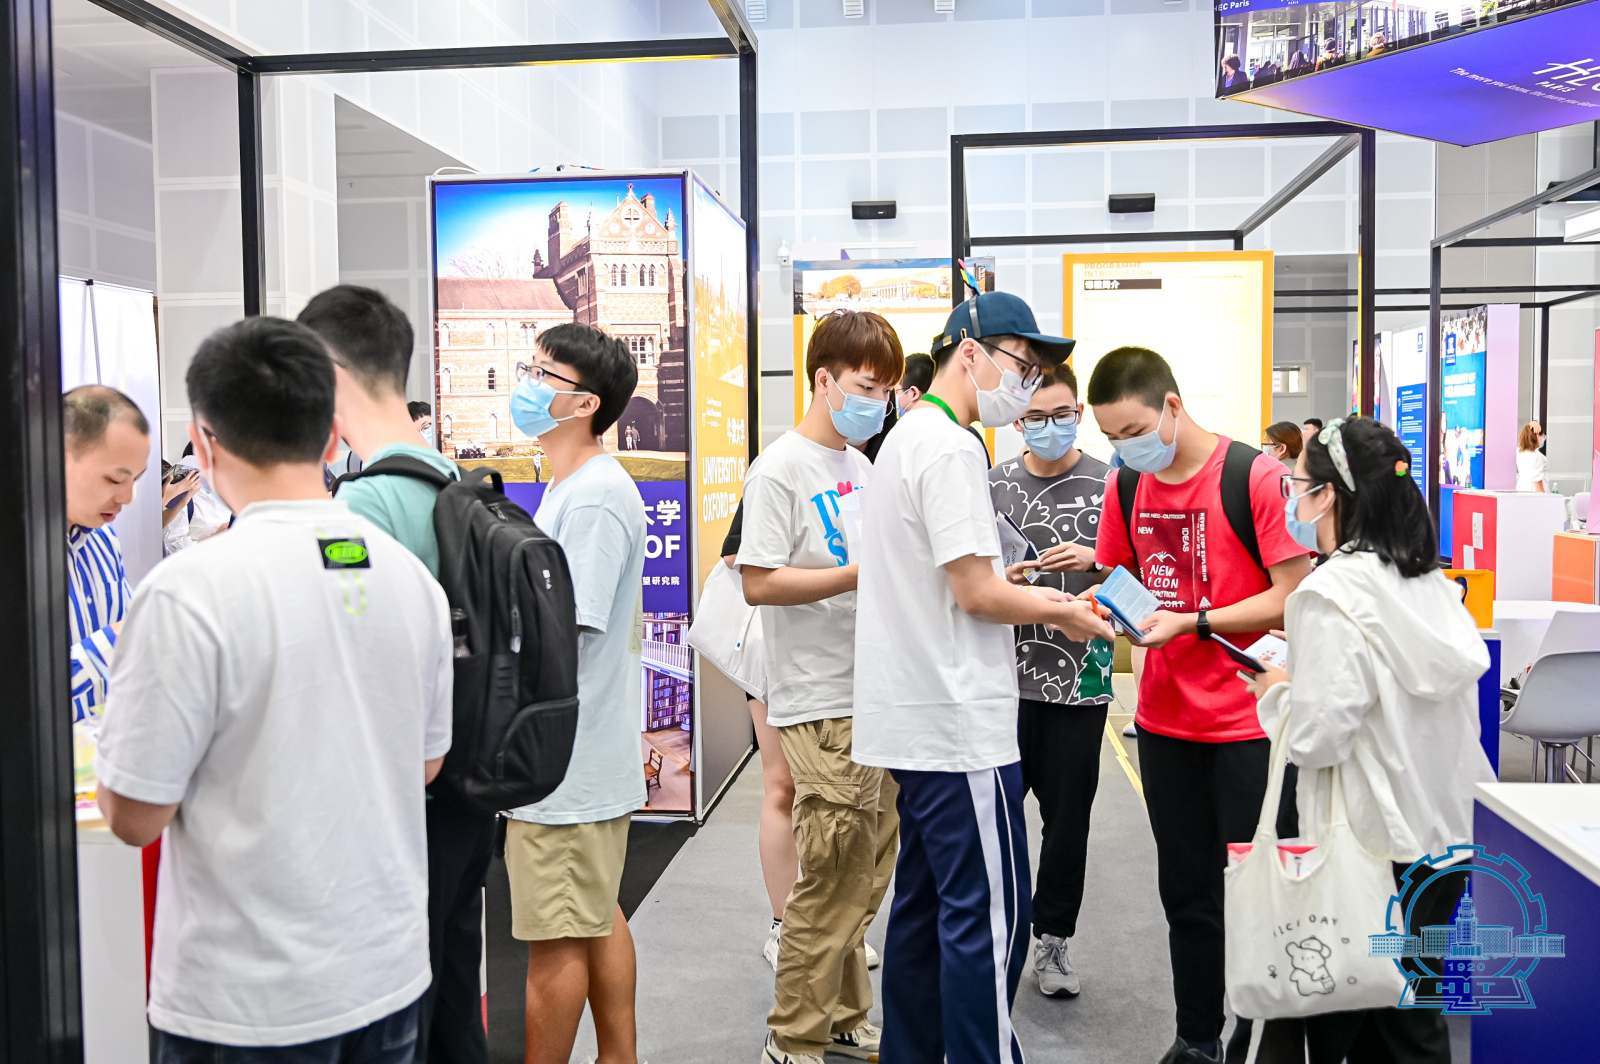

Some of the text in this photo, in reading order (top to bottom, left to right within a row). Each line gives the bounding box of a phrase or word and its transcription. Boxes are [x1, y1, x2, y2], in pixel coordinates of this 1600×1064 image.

[1230, 0, 1250, 9] Paris
[1535, 81, 1576, 93] PARIS
[1084, 262, 1142, 270] PROGRAMME
[1084, 269, 1153, 278] INTRODUCTION
[702, 456, 746, 486] UNIVERSITY OF
[703, 491, 729, 524] OXFORD
[1137, 526, 1154, 535] NEW
[645, 534, 681, 559] OF
[1181, 527, 1190, 553] IDEAS
[1199, 533, 1207, 550] STOP
[1149, 564, 1175, 577] NEW
[1200, 550, 1208, 582] EXPLORING
[1147, 576, 1179, 589] ICON
